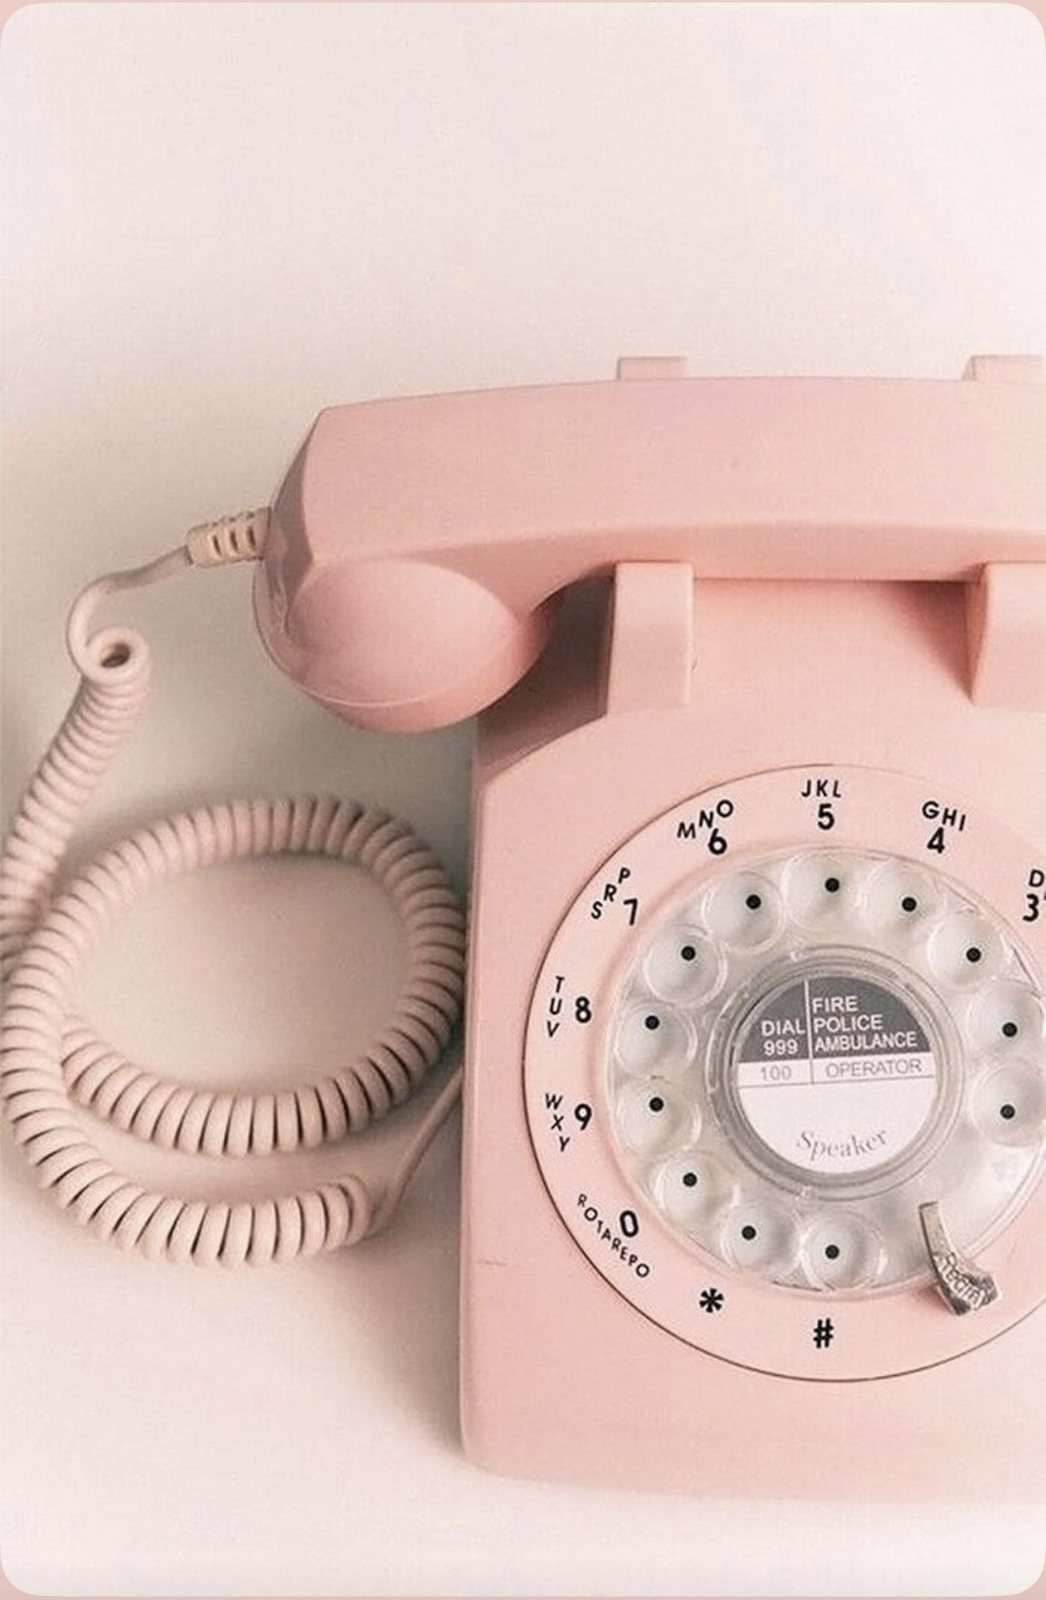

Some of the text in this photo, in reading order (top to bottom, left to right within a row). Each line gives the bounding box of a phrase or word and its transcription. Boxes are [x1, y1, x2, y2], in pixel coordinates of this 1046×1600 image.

[802, 779, 842, 798] JKL
[677, 799, 734, 839] MNO
[817, 803, 835, 831] 5
[921, 800, 967, 832] GHI
[708, 828, 728, 856] 6
[926, 827, 946, 854] 4
[623, 897, 638, 926] 7
[1022, 893, 1040, 922] 3
[575, 996, 592, 1024] 8
[811, 995, 859, 1014] FIRE
[761, 1018, 806, 1037] DIAL
[813, 1013, 884, 1034] POLICE
[763, 1038, 799, 1057] 999
[814, 1030, 918, 1053] AMBULANCE
[760, 1058, 923, 1082] 100 OPERATOR
[574, 1103, 593, 1131] 9
[797, 1128, 887, 1161] Speaker
